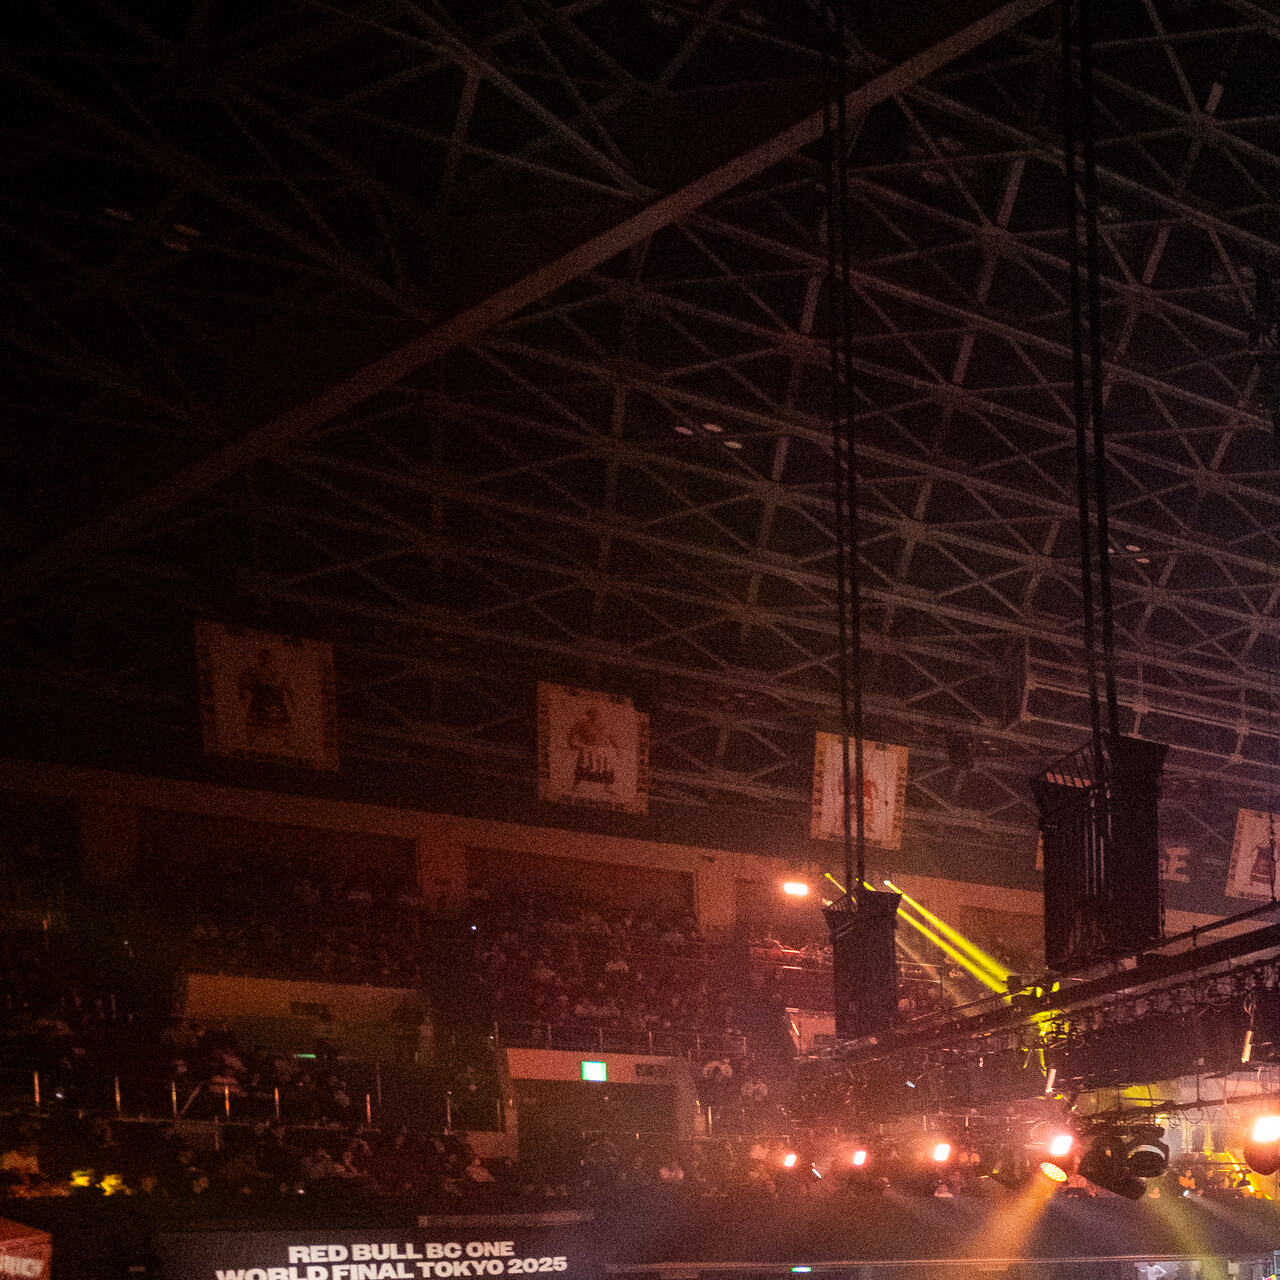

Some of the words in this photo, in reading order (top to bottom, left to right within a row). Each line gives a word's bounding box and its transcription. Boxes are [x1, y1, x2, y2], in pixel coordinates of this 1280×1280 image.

[288, 1244, 348, 1263] RED
[352, 1243, 423, 1261] BULL
[425, 1242, 462, 1259] BC
[465, 1241, 515, 1257] ONE
[416, 1259, 504, 1278] TOKYO
[507, 1256, 568, 1274] 2025
